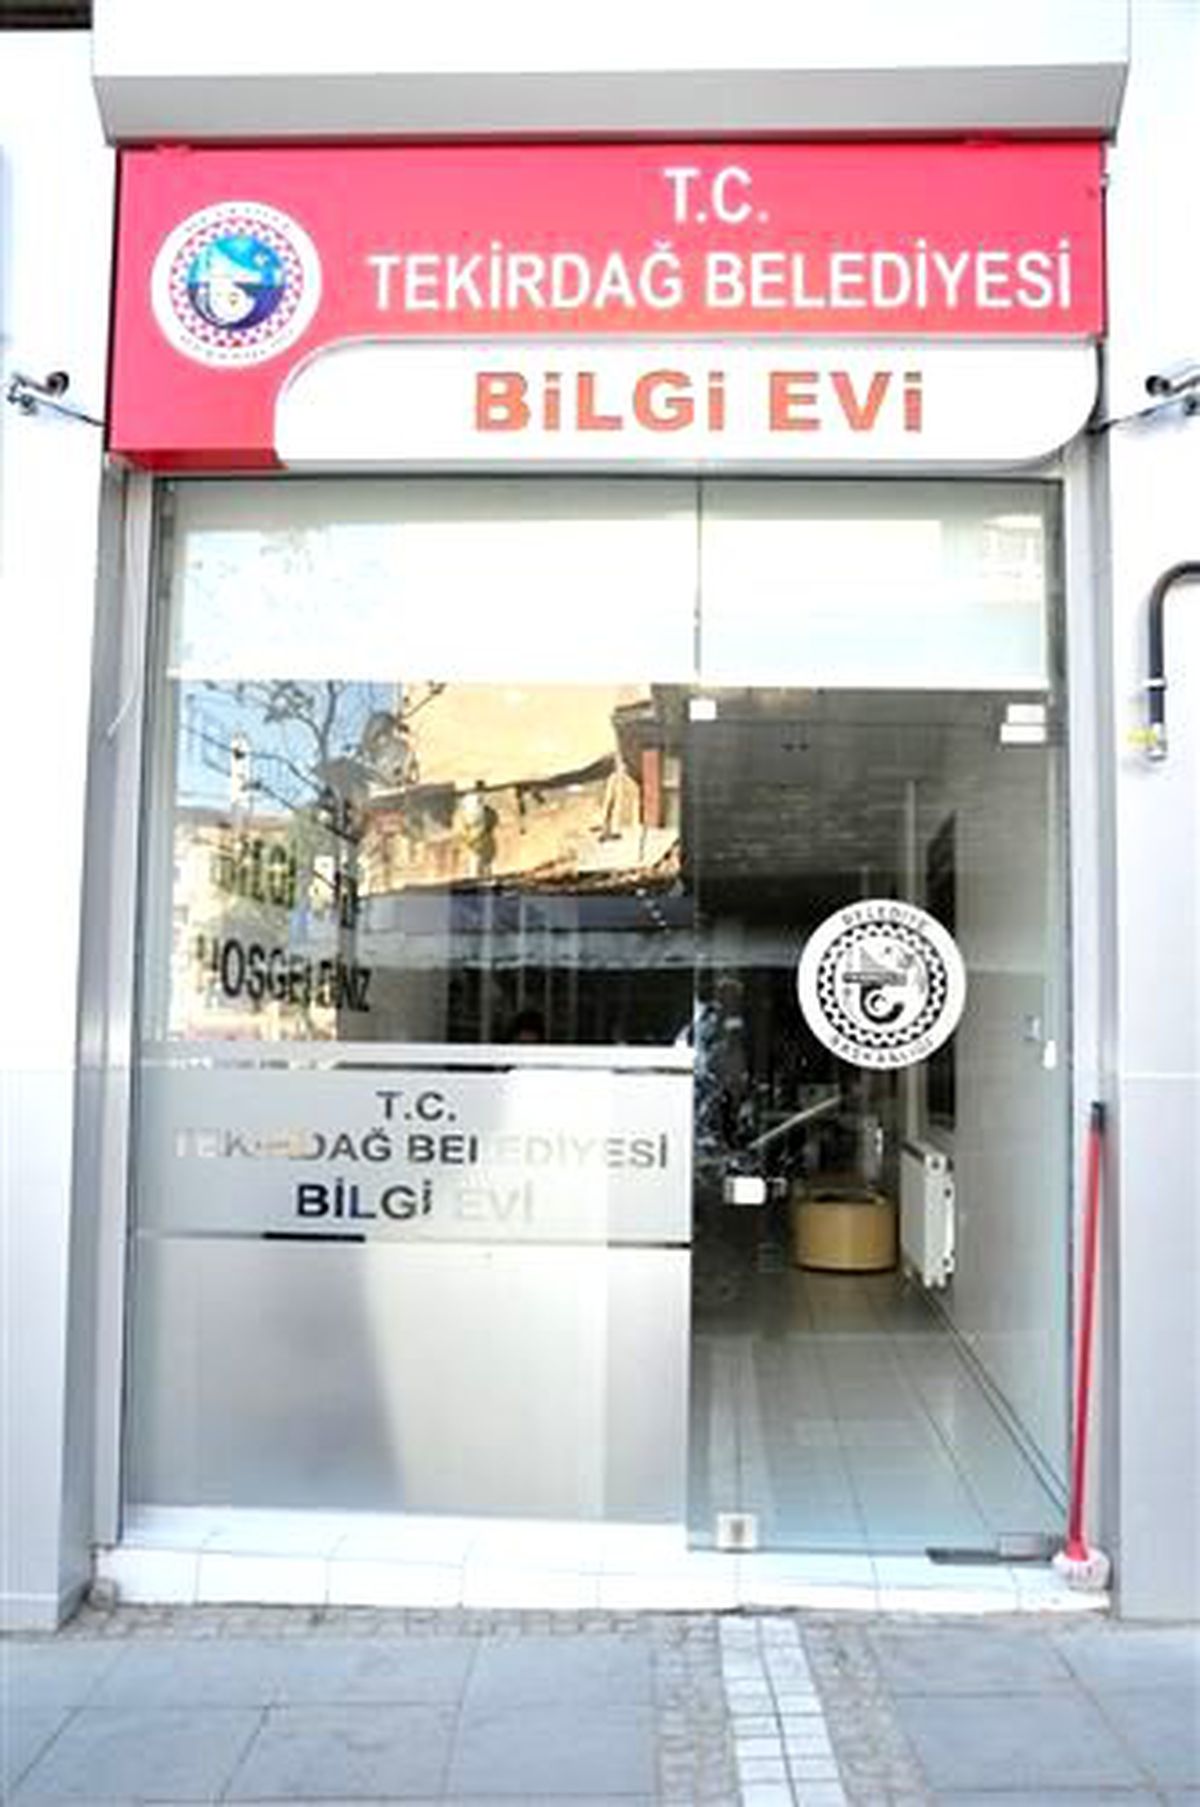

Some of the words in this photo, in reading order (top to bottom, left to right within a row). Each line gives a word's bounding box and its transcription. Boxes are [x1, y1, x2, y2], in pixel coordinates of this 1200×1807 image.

[664, 165, 768, 223] T.C.
[367, 241, 683, 310] TEKİRDAĞ
[705, 239, 1071, 308] BELEDİYESİ
[375, 1090, 457, 1122] T.C.
